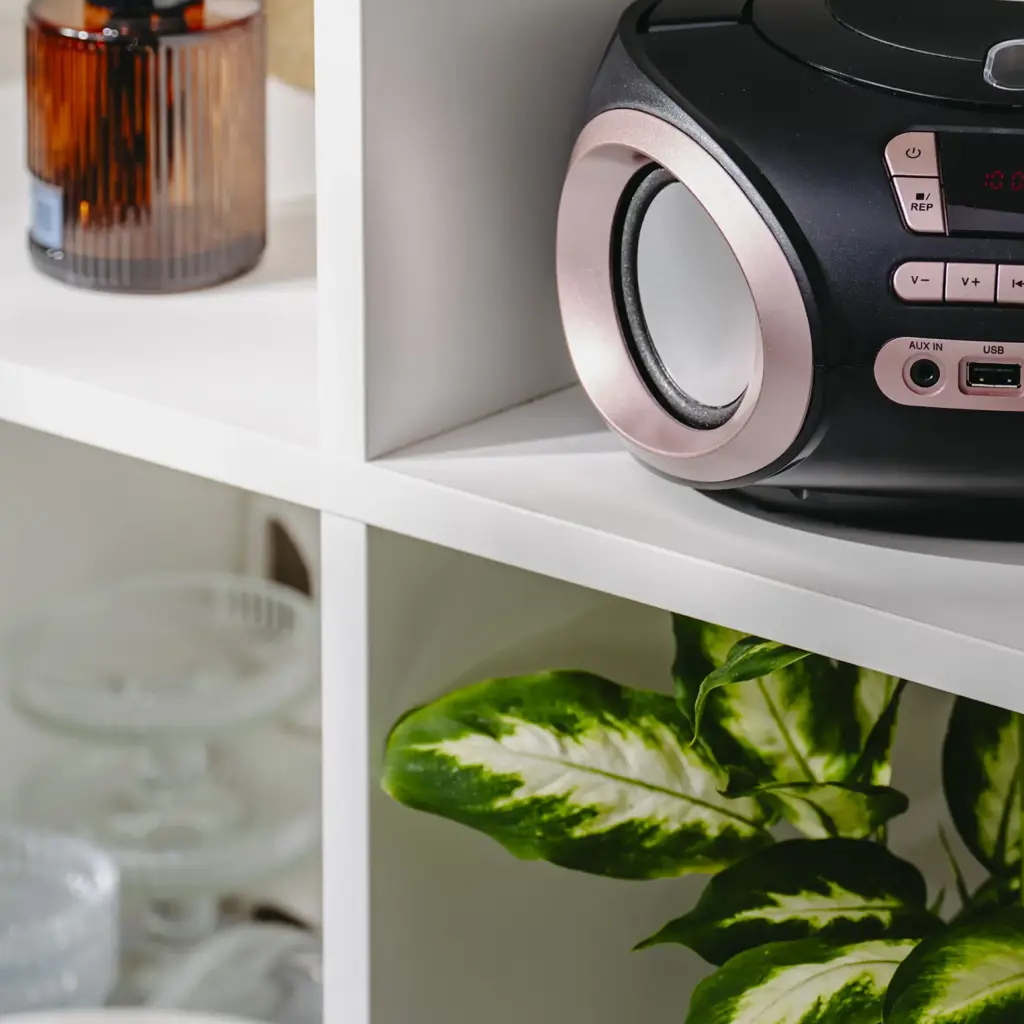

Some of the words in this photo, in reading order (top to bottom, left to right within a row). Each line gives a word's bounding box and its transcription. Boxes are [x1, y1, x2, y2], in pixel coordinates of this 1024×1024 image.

[910, 203, 934, 212] REP
[908, 340, 930, 351] AUX
[932, 342, 943, 352] IN
[983, 345, 1005, 355] USB
